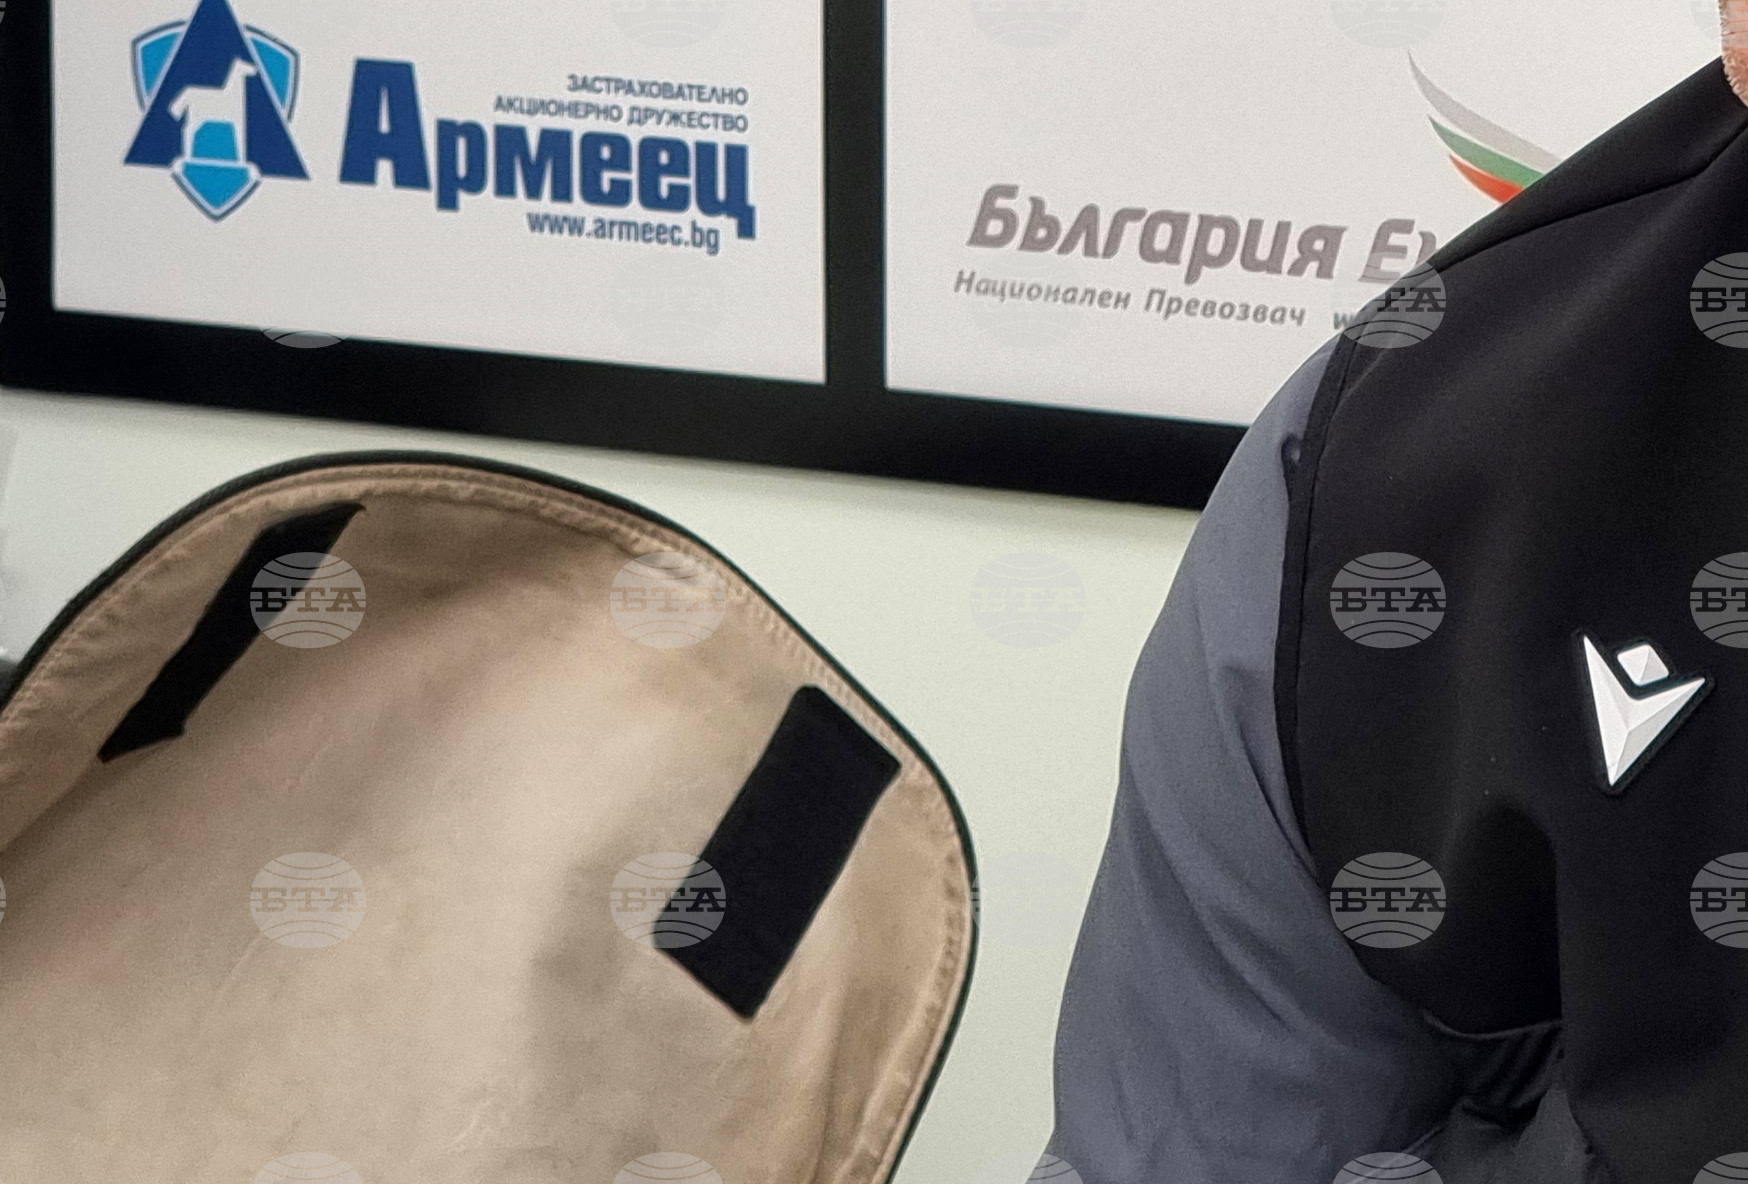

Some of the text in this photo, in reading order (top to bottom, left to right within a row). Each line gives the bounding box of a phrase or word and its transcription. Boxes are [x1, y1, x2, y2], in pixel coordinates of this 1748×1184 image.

[494, 95, 749, 133] АКЦИОНЕРНО ДРУЖЕСТВО
[567, 74, 748, 106] ЗАСТРАХОВАТЕЛНО
[339, 58, 757, 241] Армеец
[527, 212, 721, 255] www.armeec.bg
[964, 184, 1347, 285] България
[954, 270, 1132, 310] Национален
[1144, 287, 1306, 327] Превозвач
